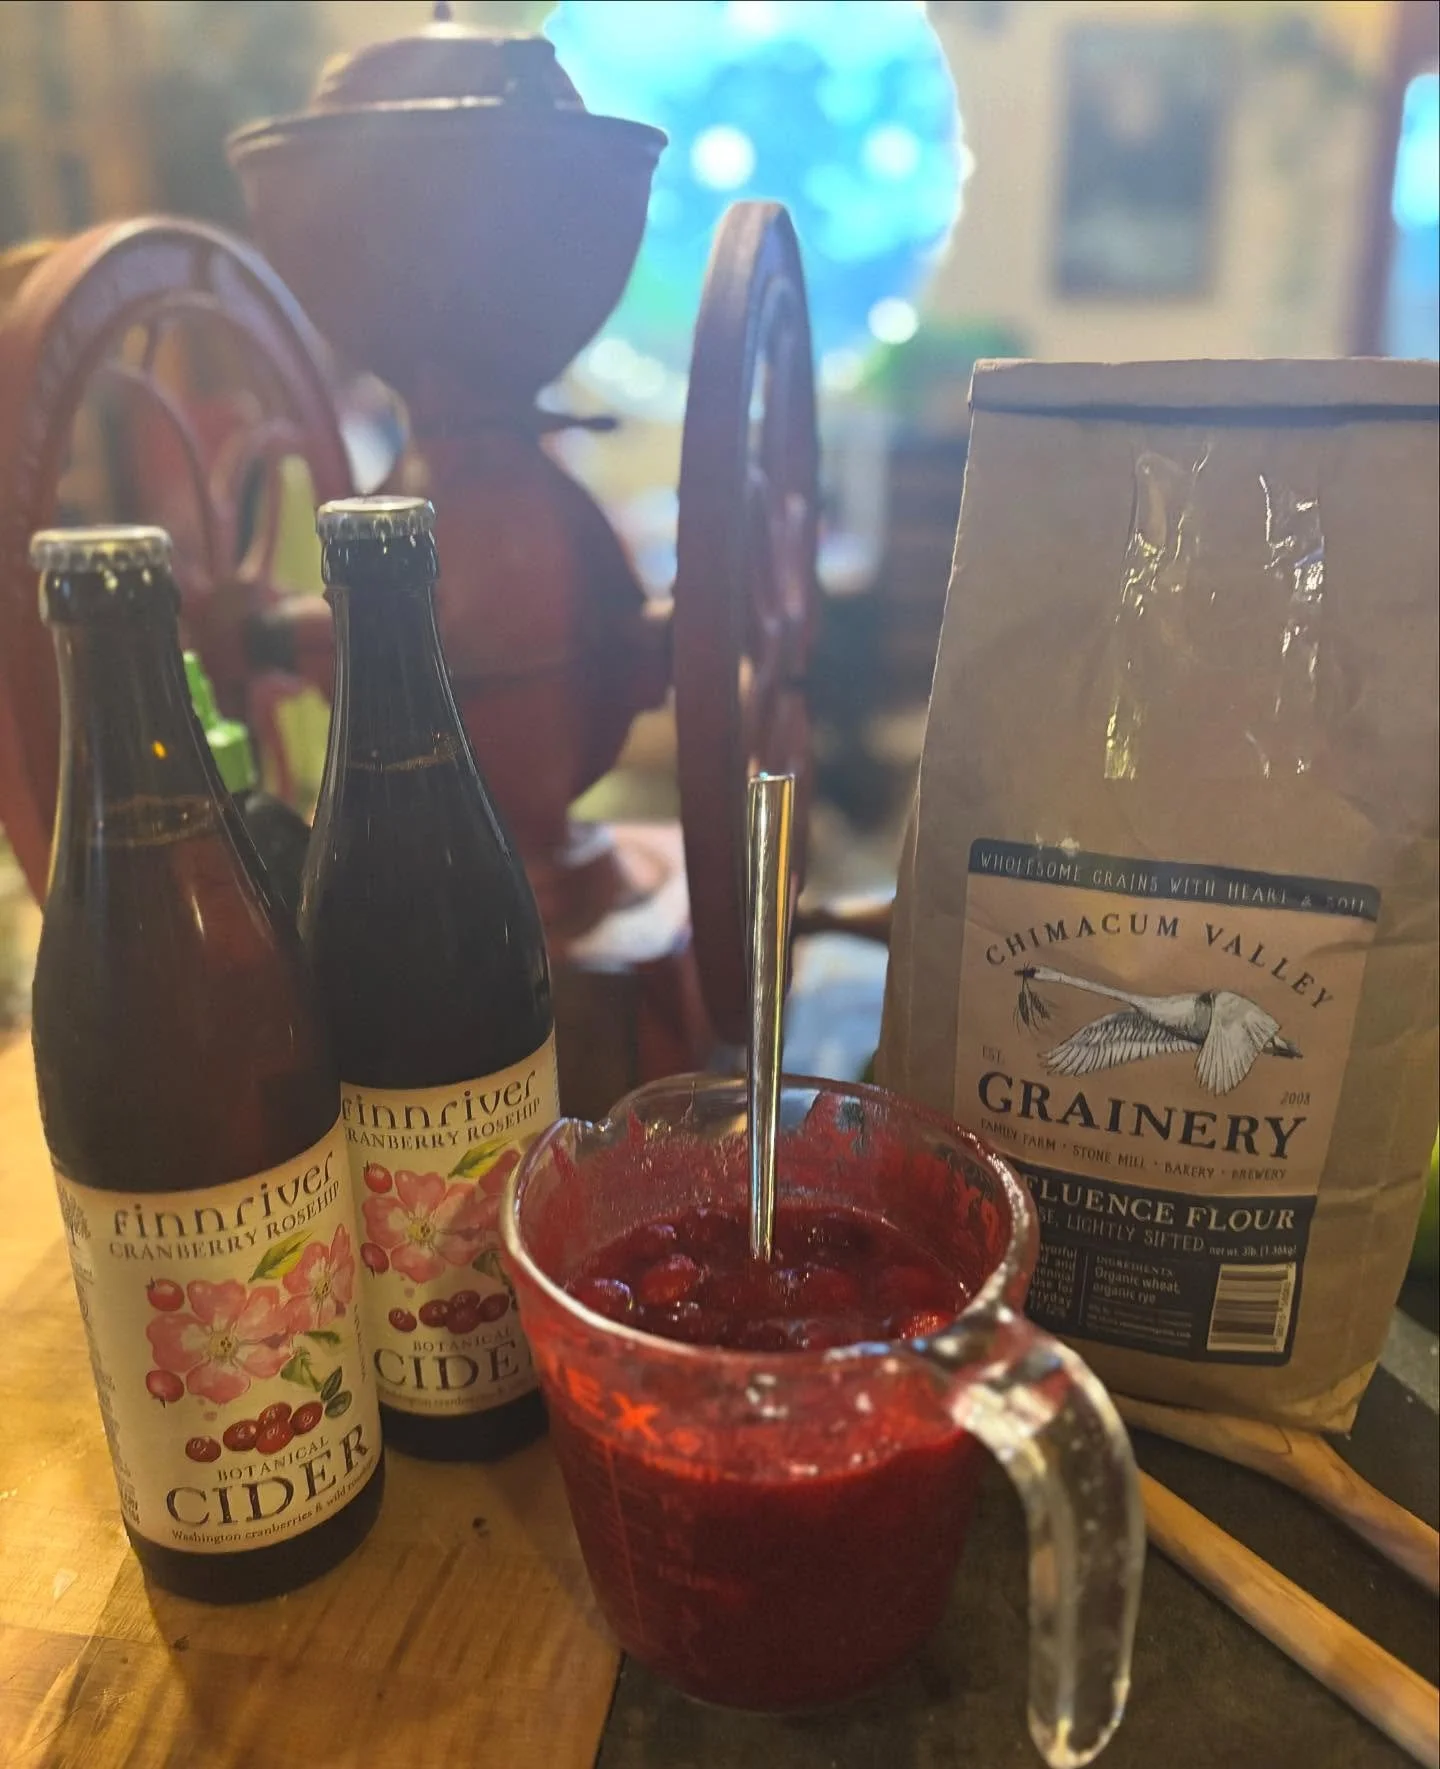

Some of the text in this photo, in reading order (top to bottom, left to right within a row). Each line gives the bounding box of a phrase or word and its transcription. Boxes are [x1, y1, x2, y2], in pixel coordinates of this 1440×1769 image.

[980, 851, 1080, 882] WHOLESOME
[1093, 869, 1157, 893] GRAINS
[1170, 876, 1215, 897] WITH
[985, 912, 1333, 1009] CHIMACUM VALLEY
[341, 1070, 536, 1130] finnriver
[344, 1097, 541, 1151] RANBERRY ROSEHIP
[977, 1070, 1307, 1160] GRAINERY
[981, 1119, 1287, 1182] FAMILY FARM STONE MILL BAKERY BREWERY
[109, 1180, 339, 1260] CRANBERRY ROSEHIP
[114, 1151, 334, 1239] finnriver
[1186, 1204, 1296, 1233] FLOUR
[1067, 1211, 1137, 1243] LIGHTLY
[1145, 1229, 1205, 1252] SIFTED
[1093, 1282, 1135, 1301] organic
[1094, 1266, 1139, 1288] Organic
[413, 1325, 511, 1352] BOTANICAL
[166, 1423, 370, 1527] CIDER
[217, 1435, 329, 1482] BOTANICAL
[171, 1528, 242, 1545] Washington
[243, 1510, 313, 1541] cranberries
[326, 1487, 346, 1507] wild
